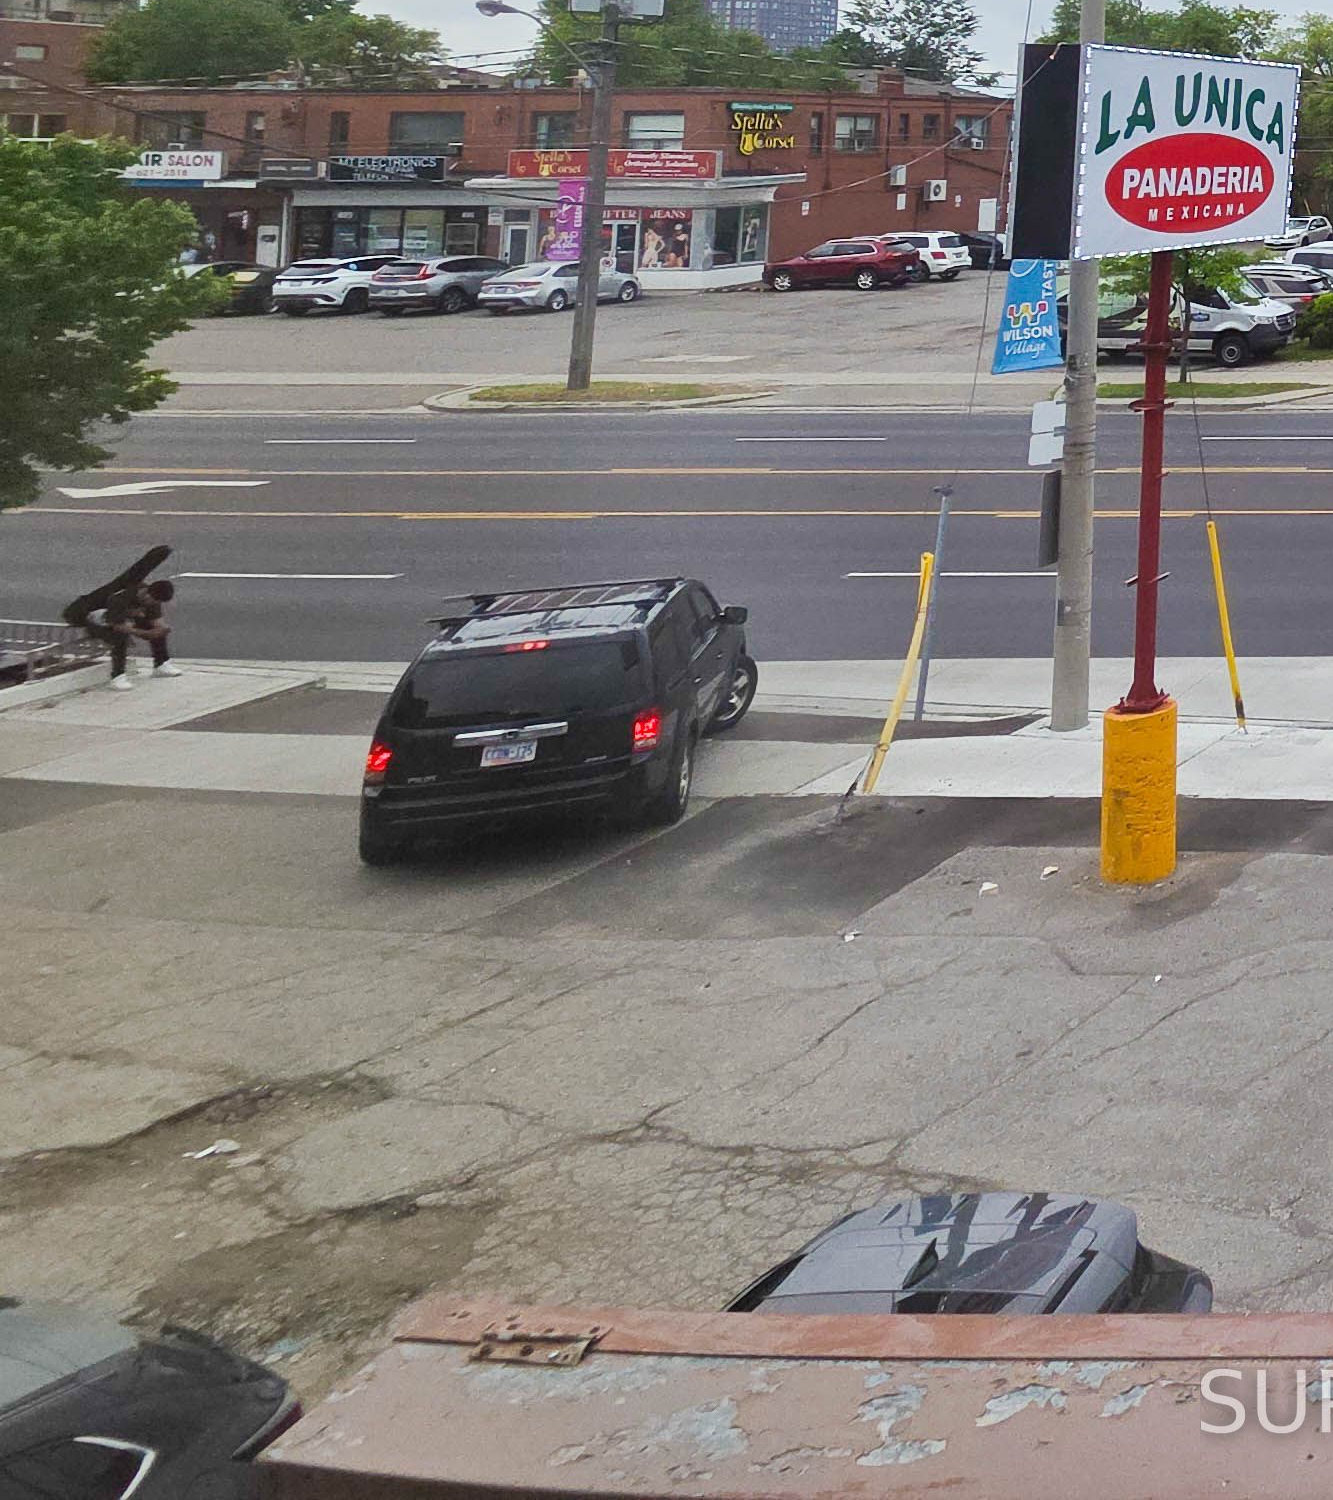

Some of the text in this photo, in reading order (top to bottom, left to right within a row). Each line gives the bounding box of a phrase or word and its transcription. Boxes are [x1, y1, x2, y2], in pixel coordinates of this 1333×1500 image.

[1094, 71, 1285, 156] LA UNICA
[167, 154, 214, 167] SALON
[1121, 165, 1264, 200] PANADERIA
[603, 209, 687, 219] IFTER JEANS
[1147, 203, 1246, 222] MEXICANA
[1003, 325, 1054, 342] WILSON
[1005, 341, 1047, 359] Village
